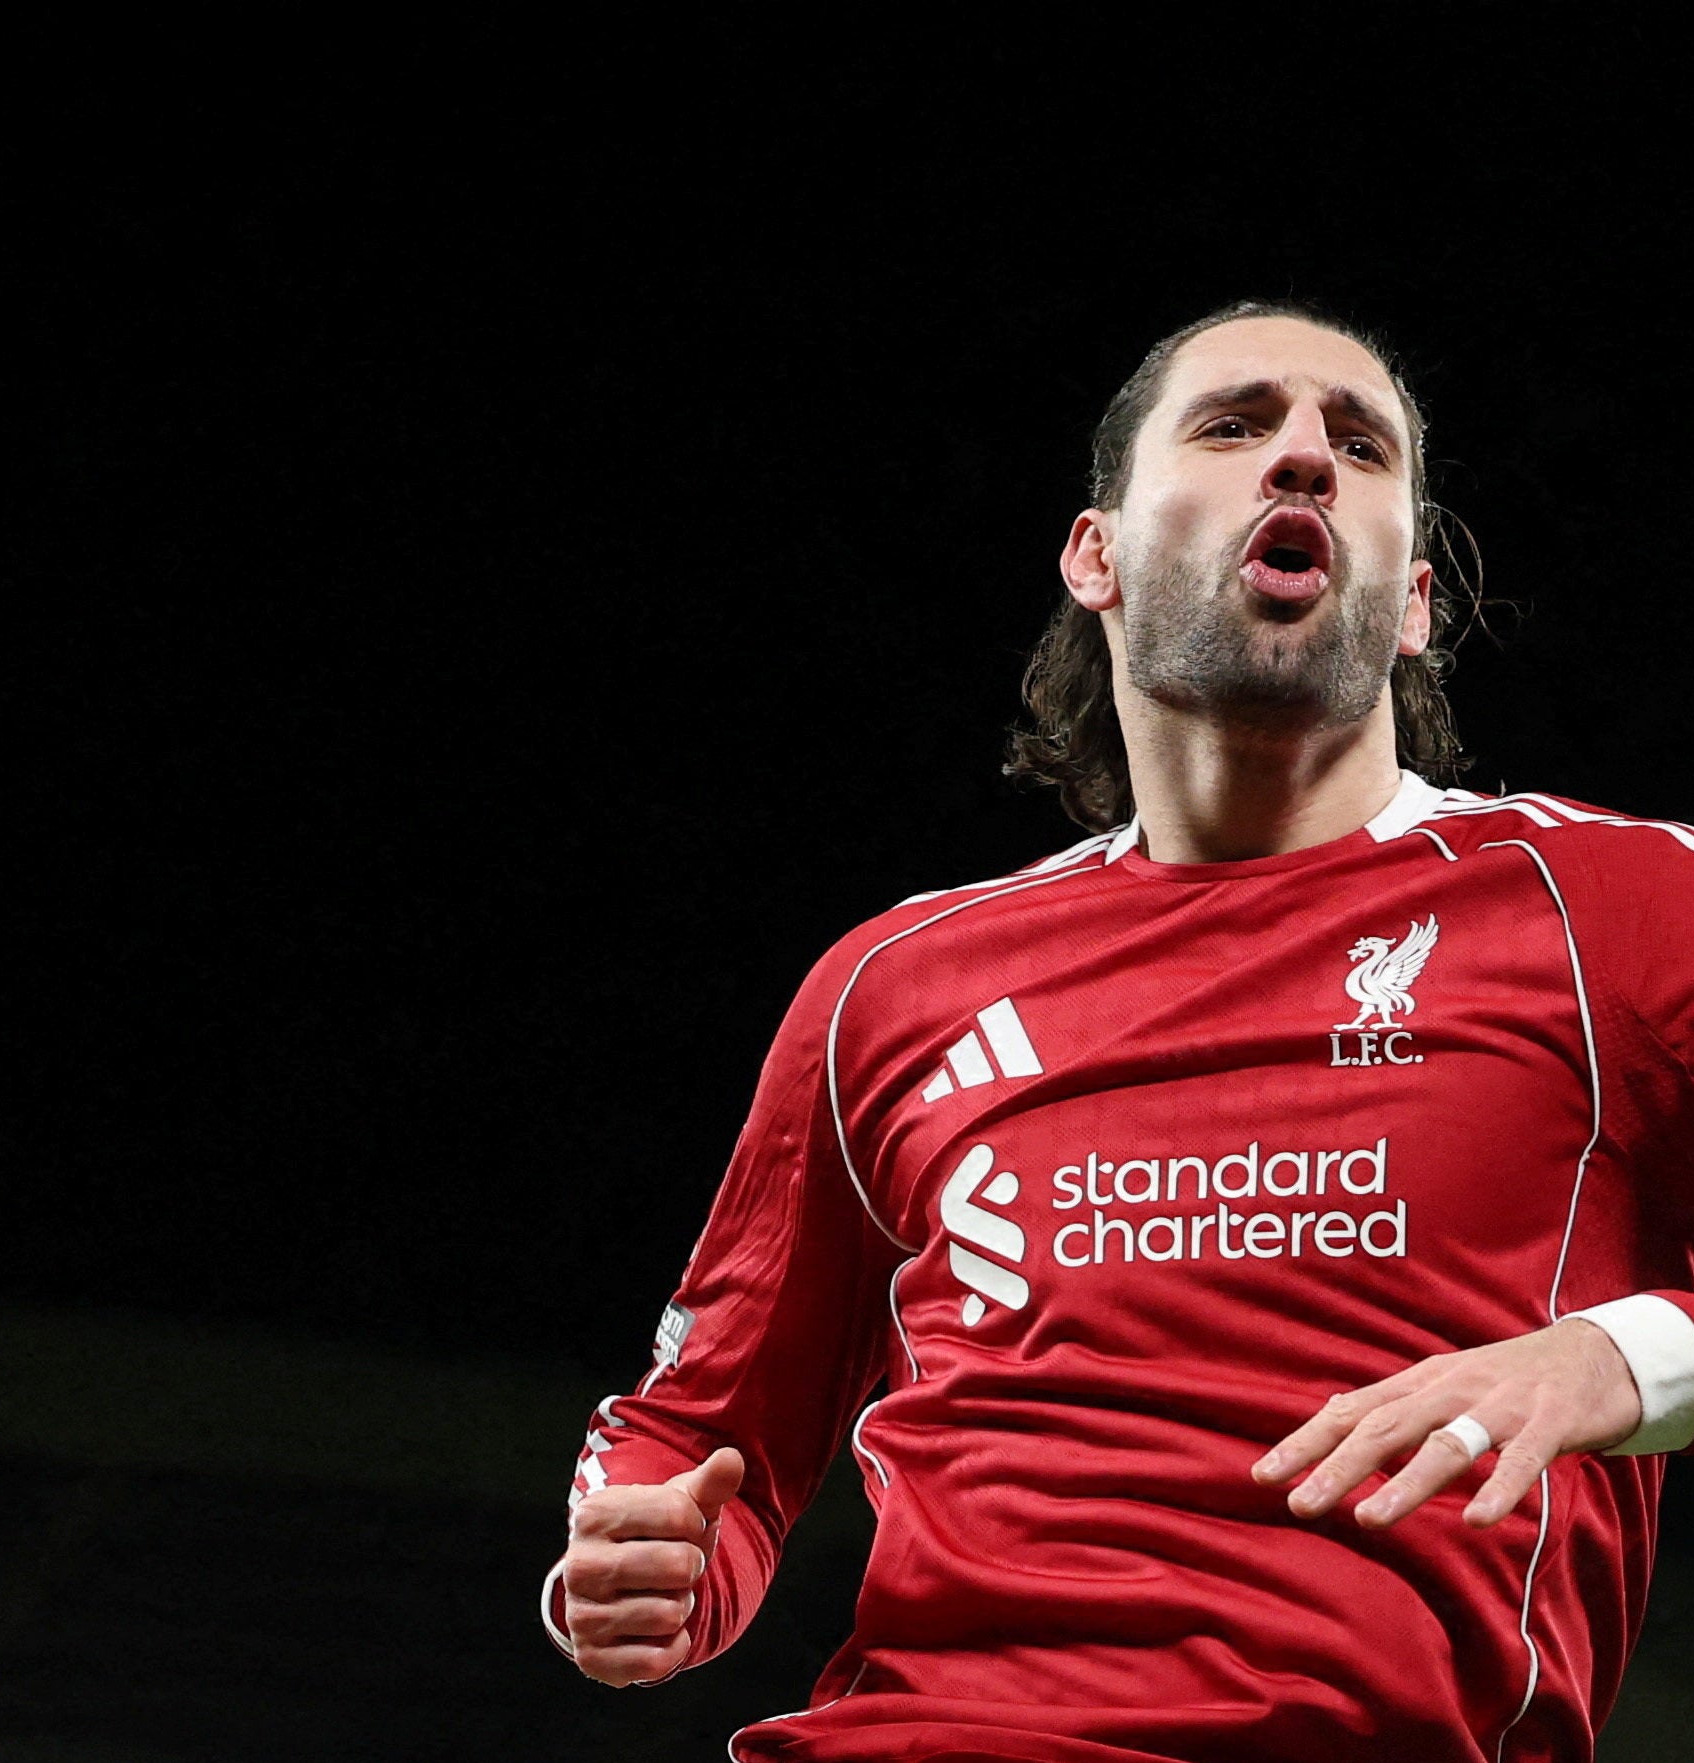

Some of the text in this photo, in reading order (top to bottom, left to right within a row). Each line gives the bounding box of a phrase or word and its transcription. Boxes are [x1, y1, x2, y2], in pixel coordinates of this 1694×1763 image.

[1329, 1031, 1424, 1067] L.F.C.
[1052, 1137, 1387, 1210] standard
[1052, 1198, 1407, 1267] chartered
